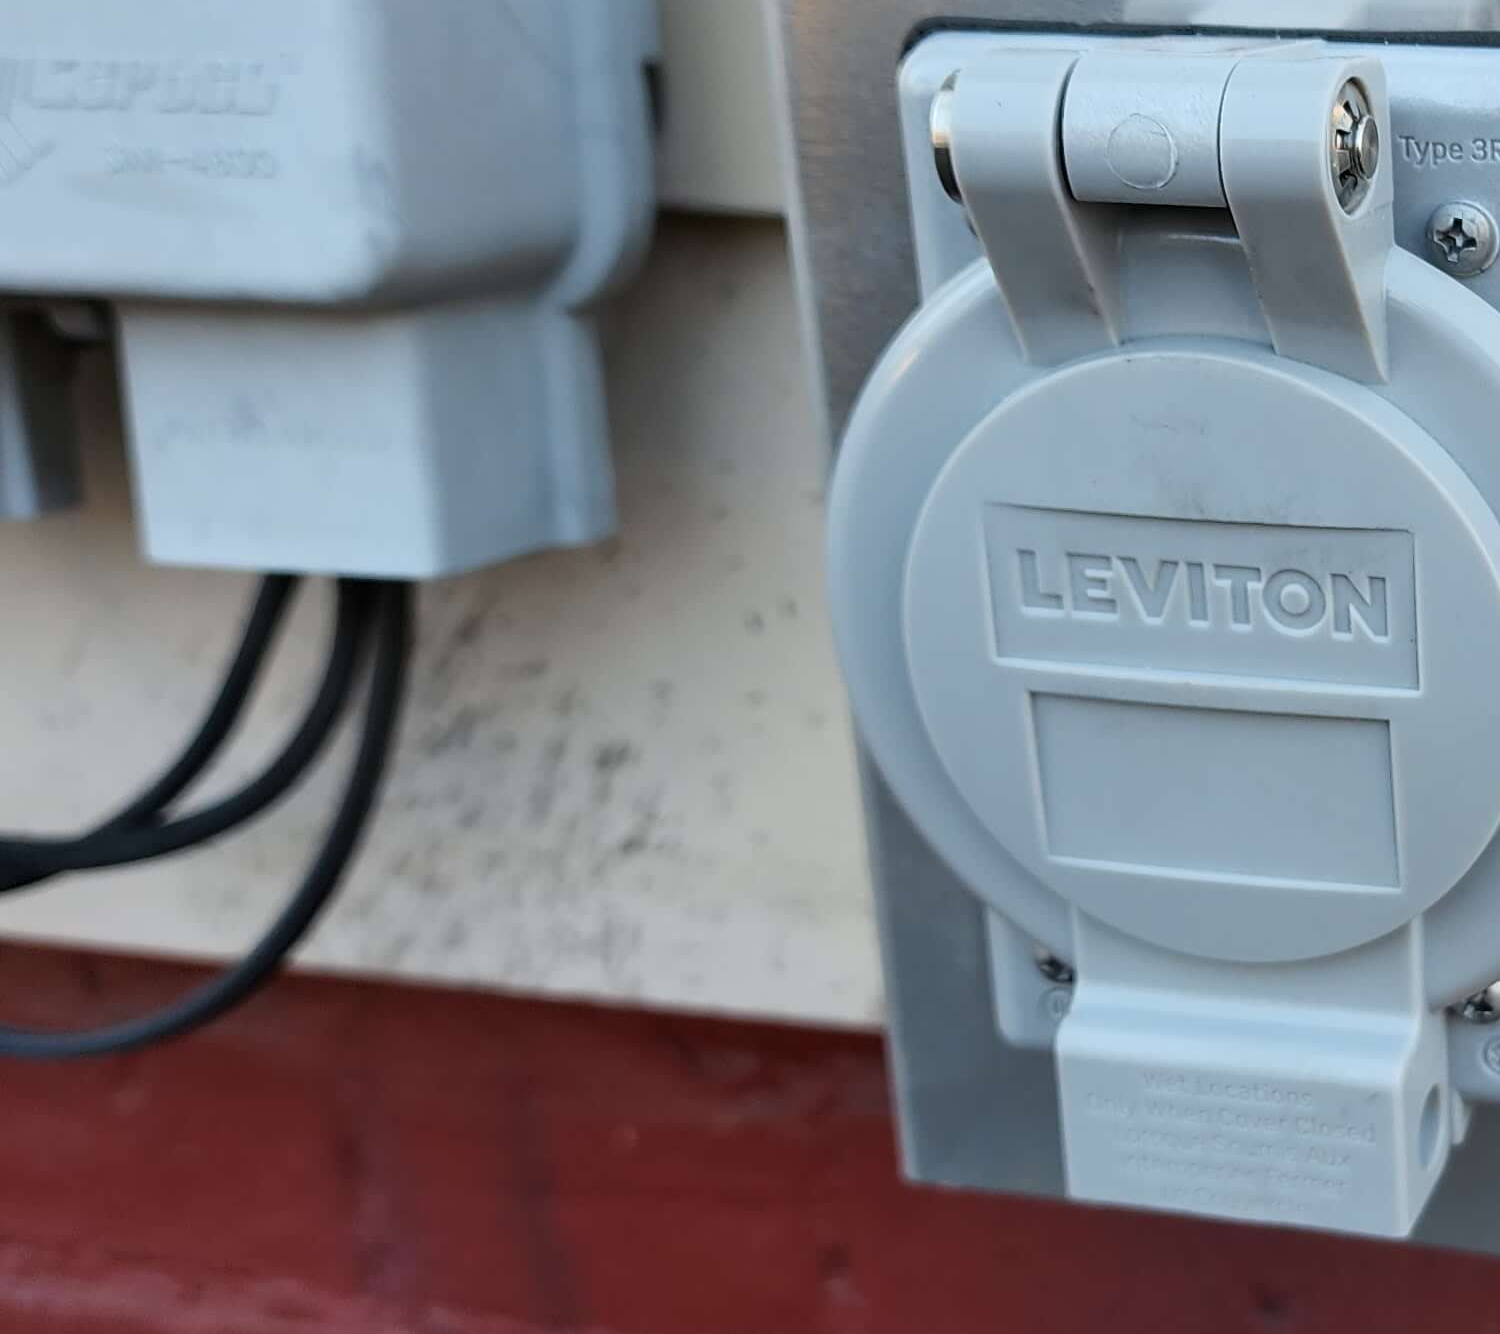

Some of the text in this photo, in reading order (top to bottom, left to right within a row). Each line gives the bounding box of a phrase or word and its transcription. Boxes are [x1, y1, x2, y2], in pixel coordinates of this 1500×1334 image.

[1398, 134, 1464, 168] Type
[1016, 548, 1391, 643] LEVITON
[1199, 1077, 1314, 1108] Locations
[1218, 1106, 1290, 1133] Cover
[1296, 1114, 1377, 1144] Closed
